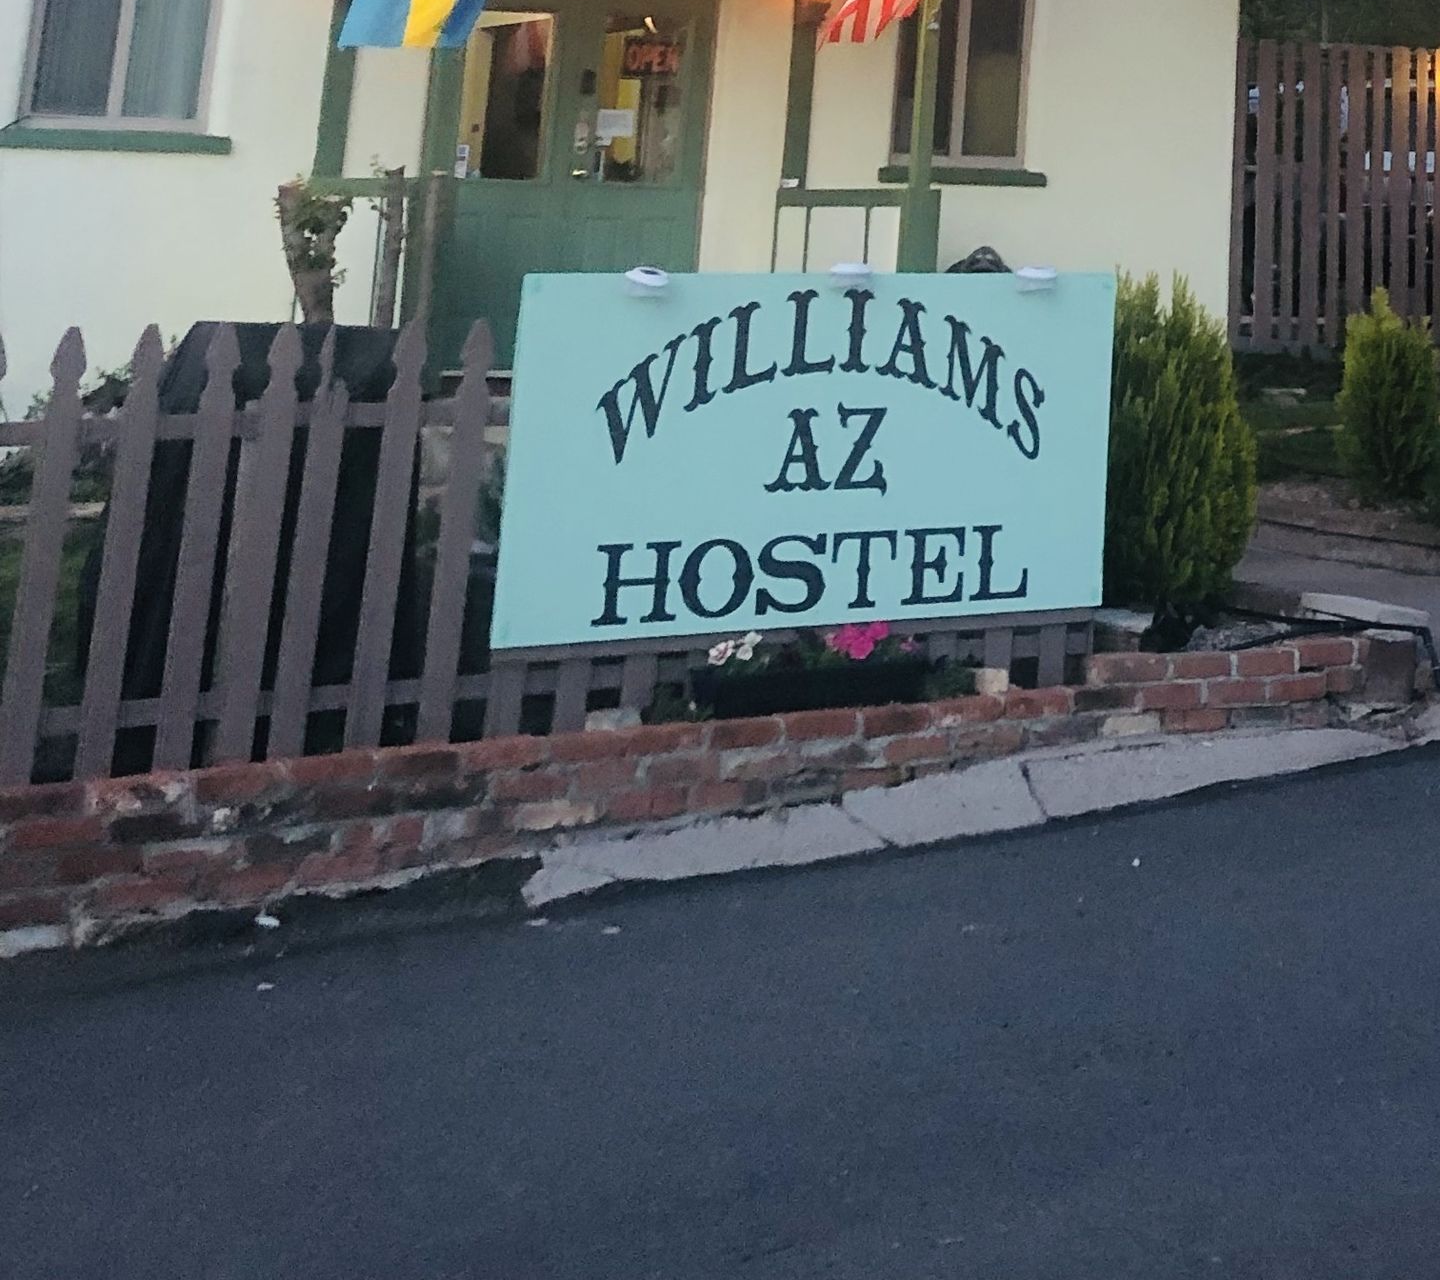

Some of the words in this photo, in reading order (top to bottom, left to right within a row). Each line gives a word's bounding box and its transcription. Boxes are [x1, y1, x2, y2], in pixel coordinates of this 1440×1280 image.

[627, 44, 679, 73] OPEN
[596, 289, 1046, 465] WILLIAMS
[763, 402, 888, 497] AZ
[591, 524, 1029, 627] HOSTEL
